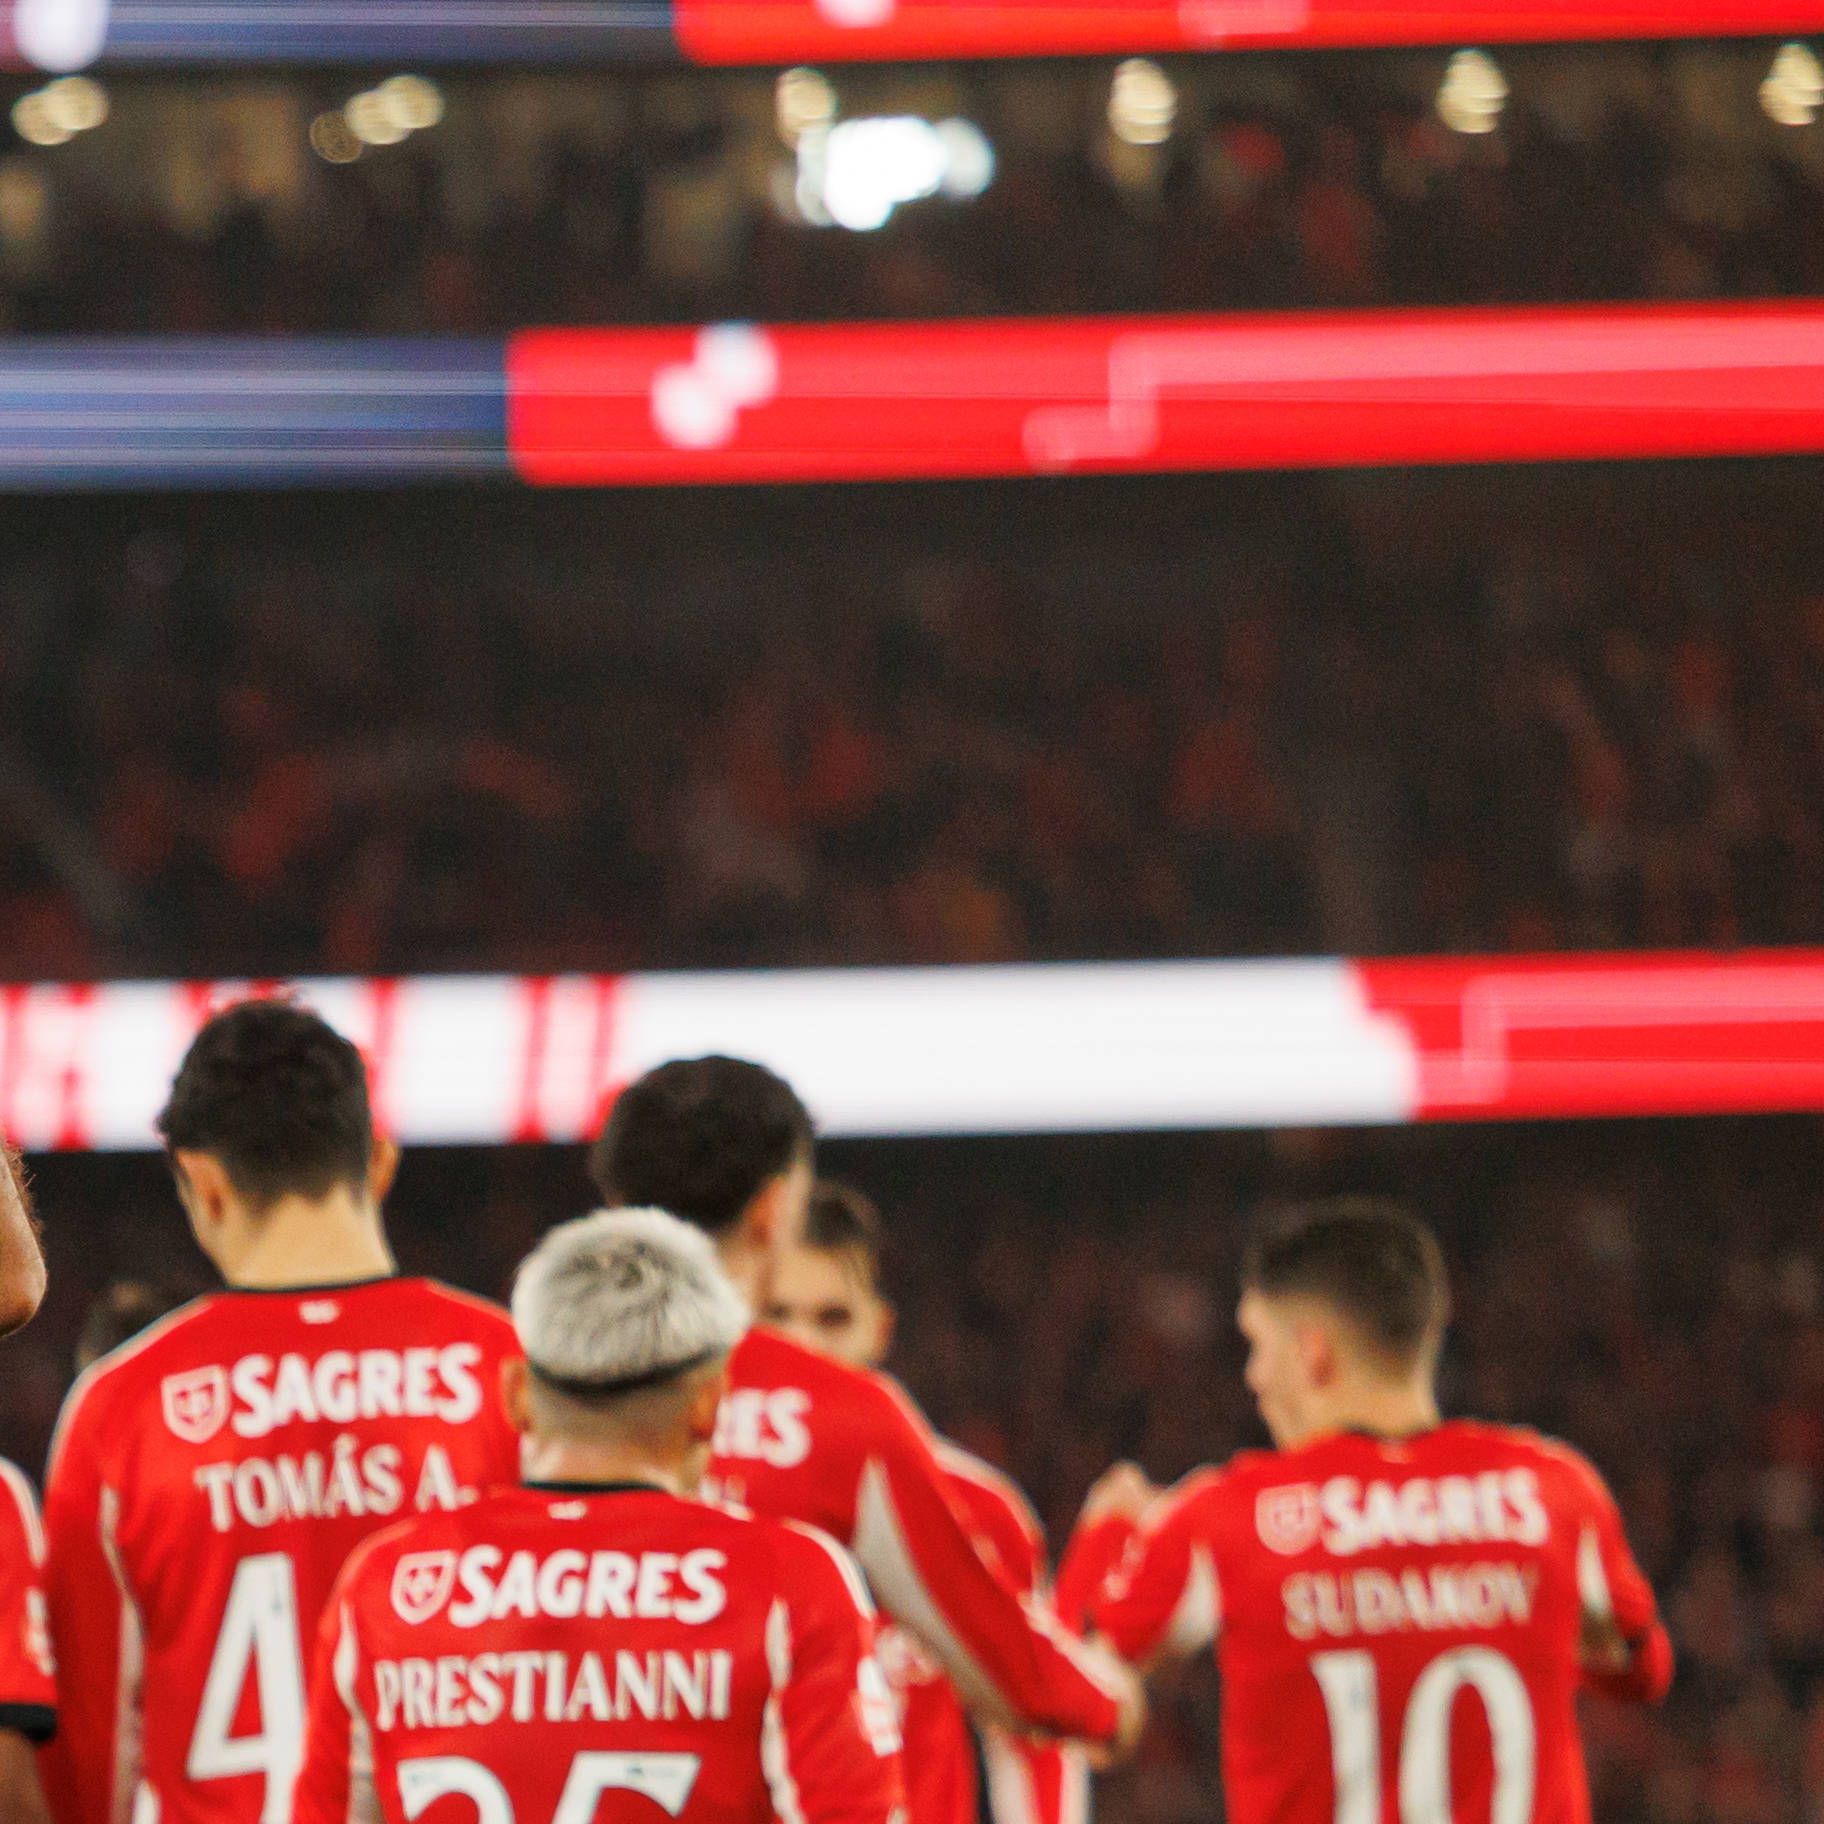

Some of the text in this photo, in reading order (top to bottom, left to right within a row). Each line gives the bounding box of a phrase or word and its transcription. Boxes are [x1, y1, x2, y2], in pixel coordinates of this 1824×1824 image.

[231, 1342, 484, 1438] SAGRES
[414, 1443, 480, 1512] A.
[1319, 1466, 1548, 1557] SAGRES
[448, 1544, 728, 1628] SAGRES
[374, 1649, 734, 1732] PRESTIANNI
